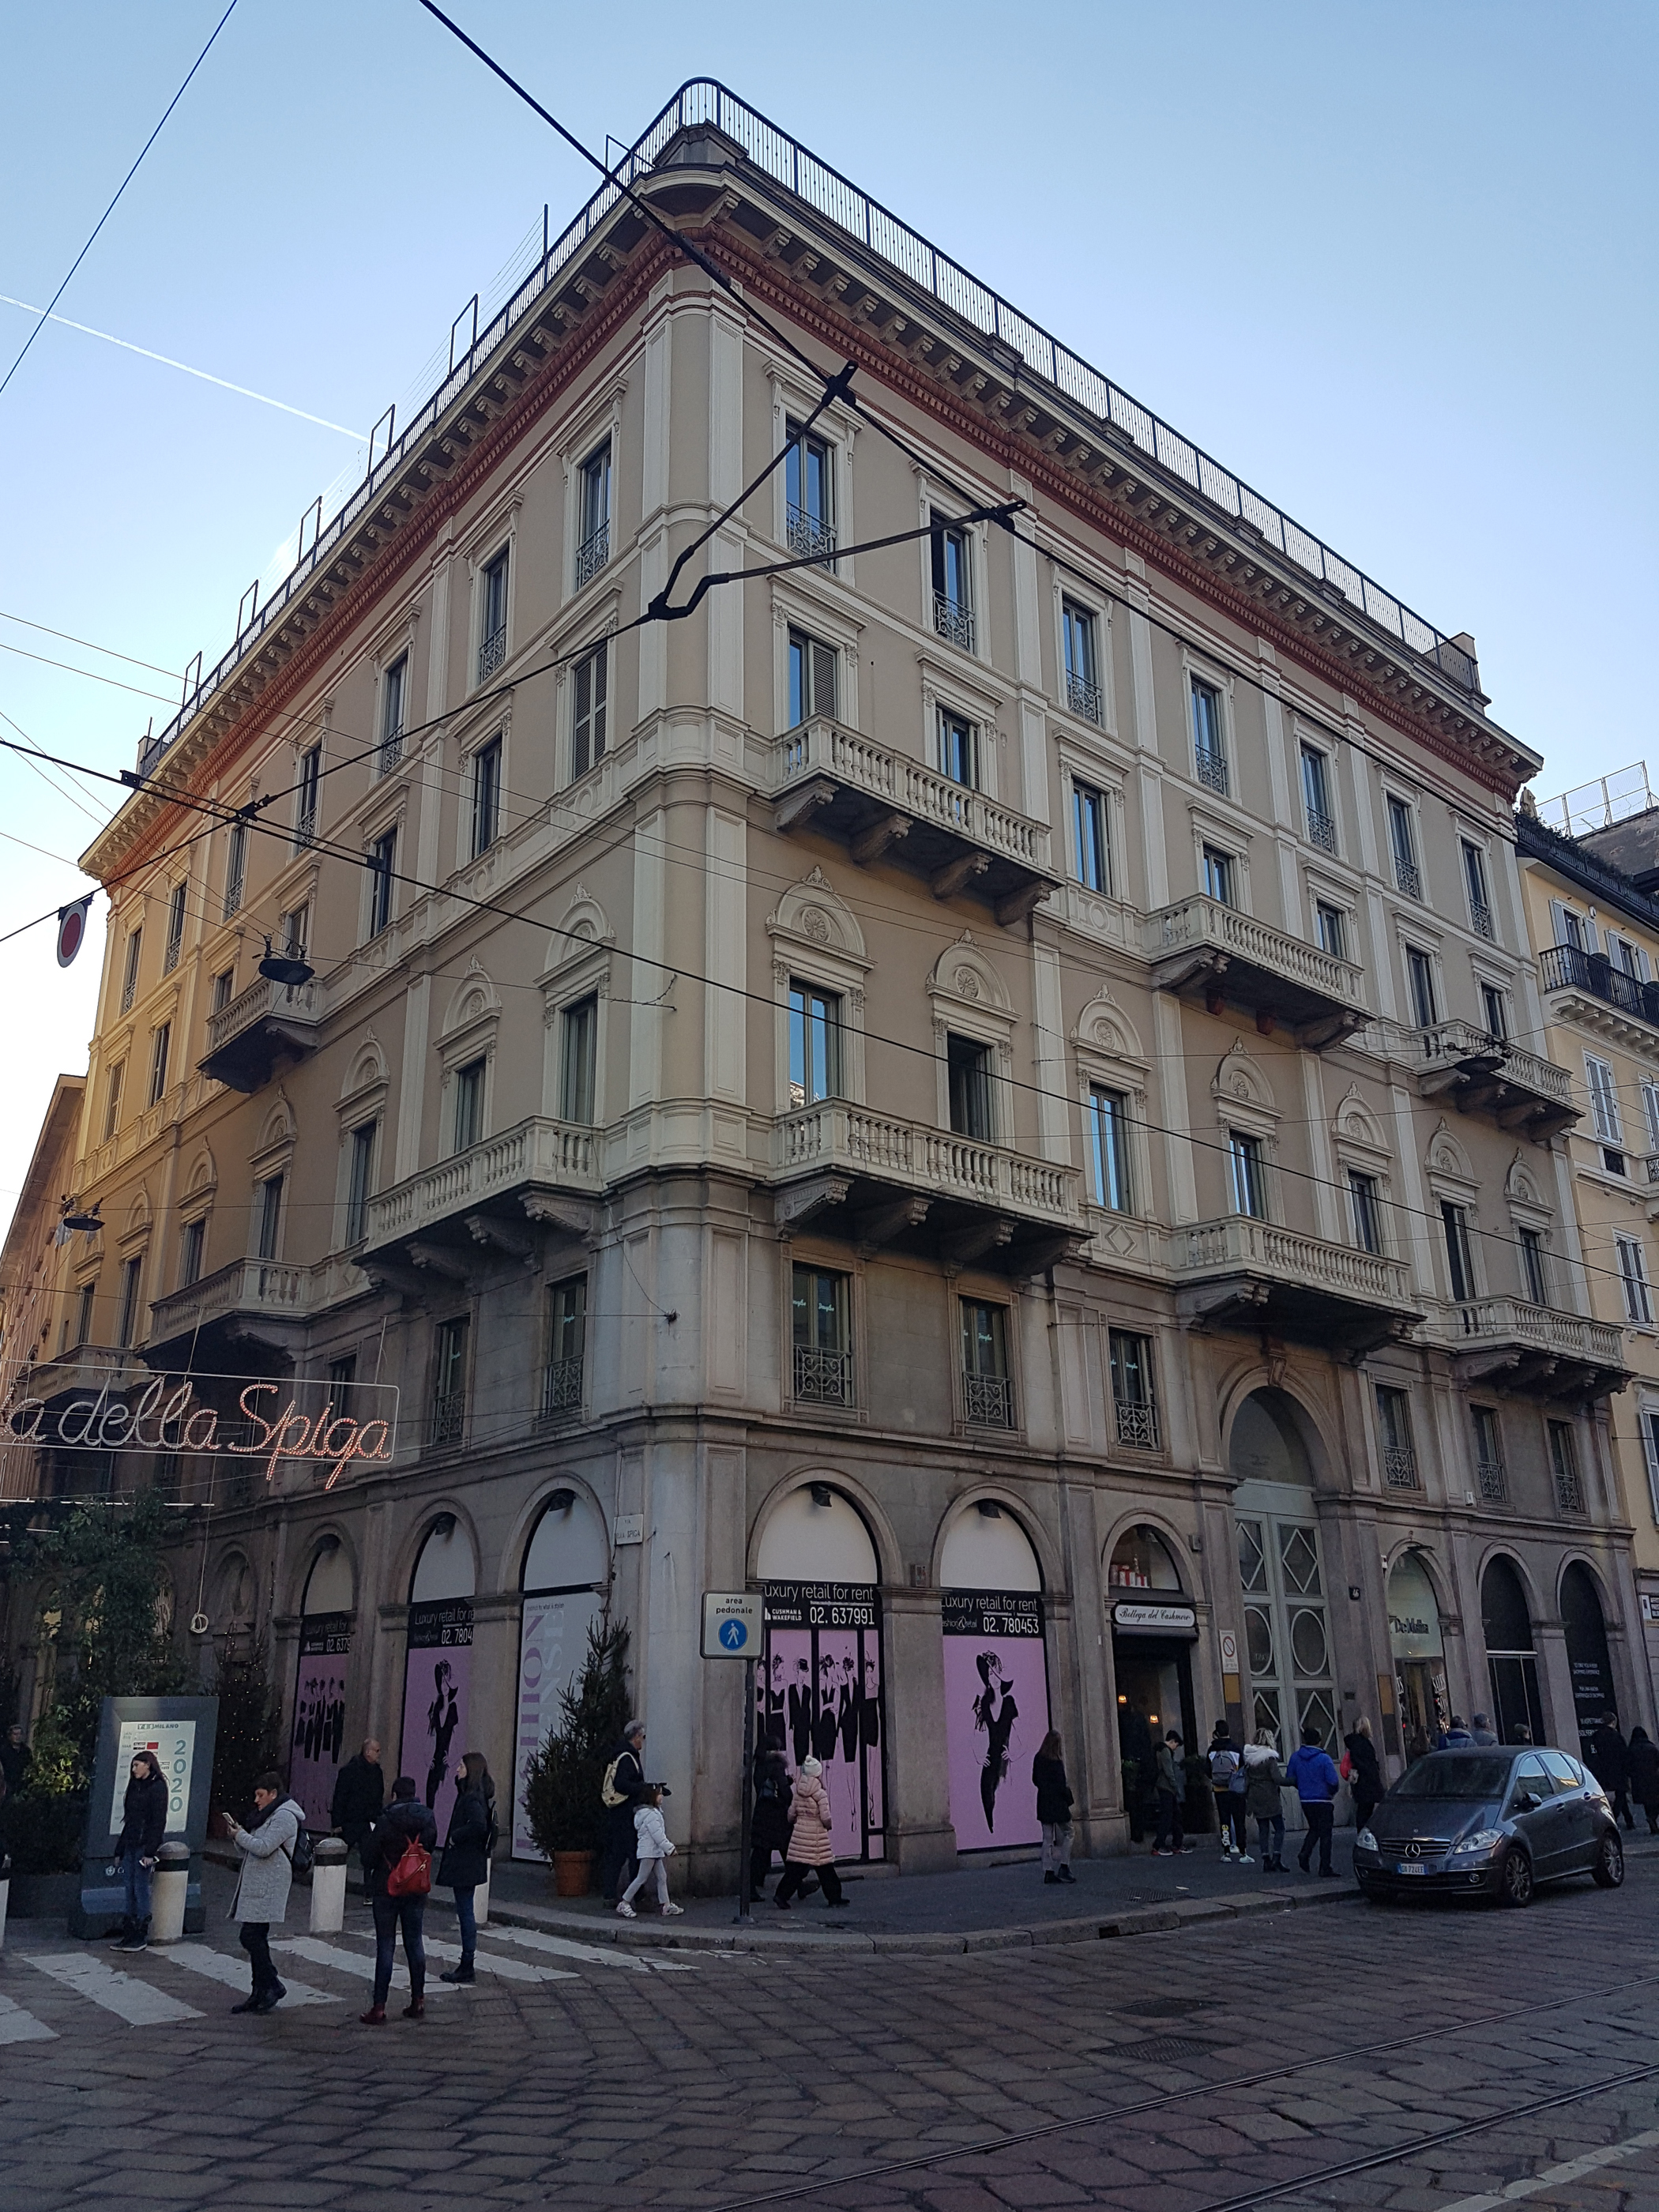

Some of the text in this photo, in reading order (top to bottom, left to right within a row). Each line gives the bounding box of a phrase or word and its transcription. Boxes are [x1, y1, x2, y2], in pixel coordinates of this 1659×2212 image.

[58, 1376, 222, 1450] della
[228, 1384, 391, 1491] Spiga
[764, 1584, 875, 1601] uxury retail for rent
[716, 1606, 753, 1615] pedonale
[976, 1596, 1002, 1610] retail
[1003, 1596, 1017, 1611] for
[1018, 1598, 1039, 1612] rent
[415, 1612, 438, 1627] Luxury
[438, 1608, 456, 1623] retail
[457, 1607, 467, 1621] for
[810, 1606, 875, 1625] 02. 637991
[1119, 1607, 1191, 1623] Bottega del Cashmere
[983, 1616, 1039, 1634] 02. 780453
[454, 1627, 472, 1644] 7804
